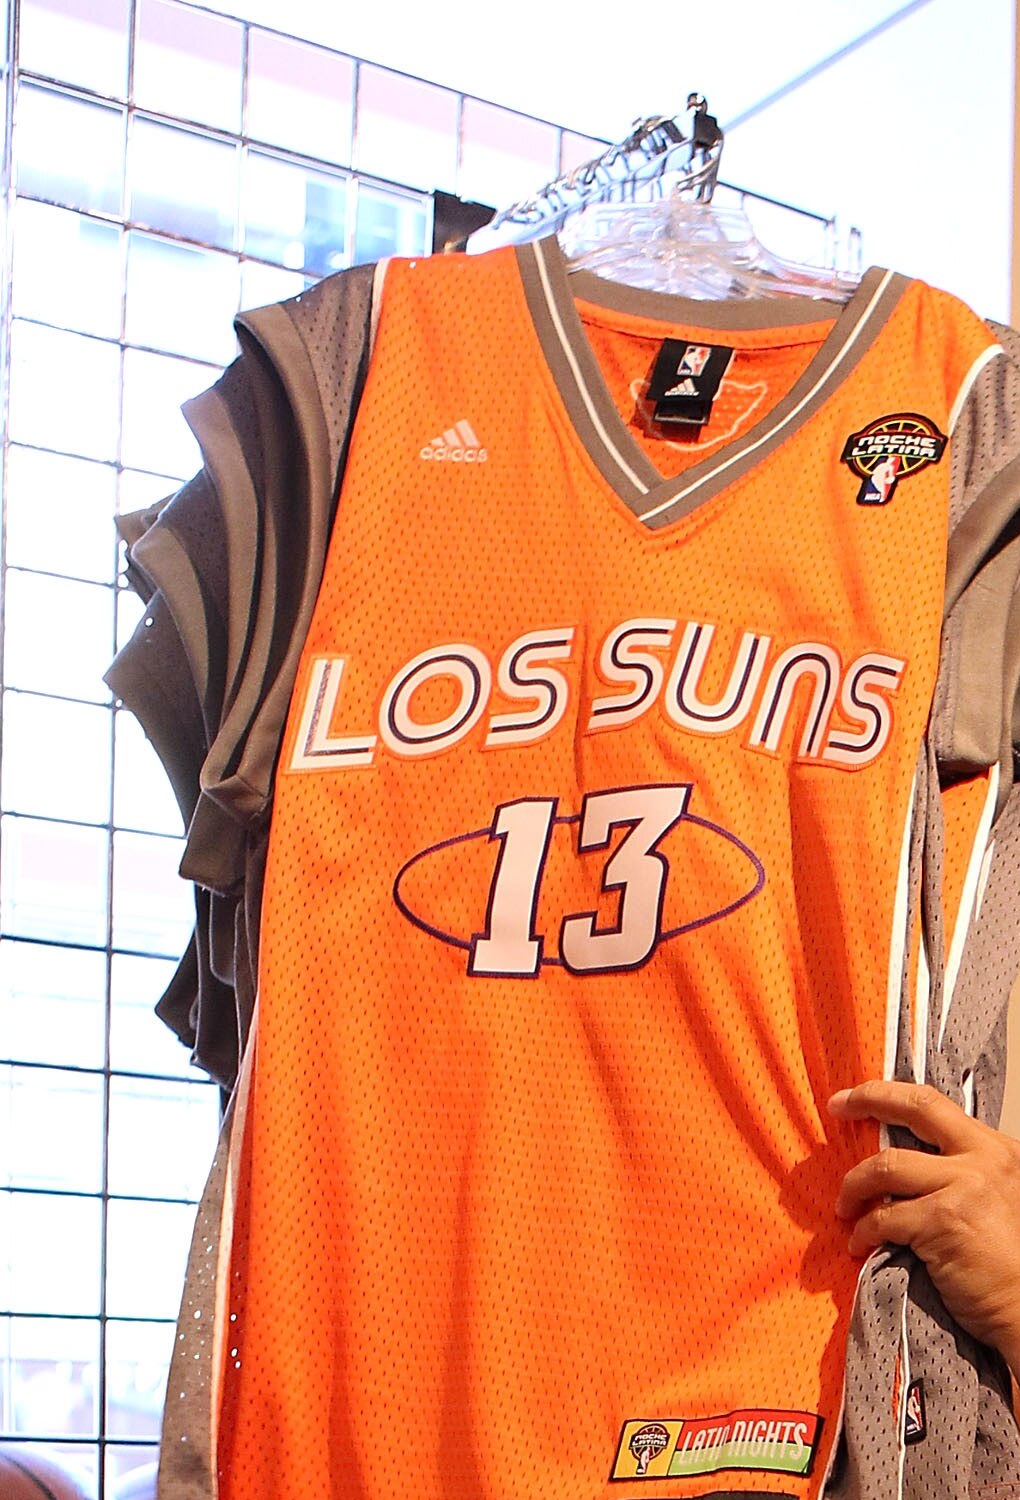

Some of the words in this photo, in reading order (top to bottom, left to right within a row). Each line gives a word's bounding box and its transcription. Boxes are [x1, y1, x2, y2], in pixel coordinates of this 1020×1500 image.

[419, 446, 489, 463] adidas
[851, 444, 936, 458] LATINA
[857, 434, 938, 448] NOCHE
[291, 627, 574, 771] LOS
[588, 617, 906, 767] SUNS
[466, 783, 694, 979] 13
[679, 1424, 731, 1465] LATIN
[727, 1419, 808, 1460] NIGHTS
